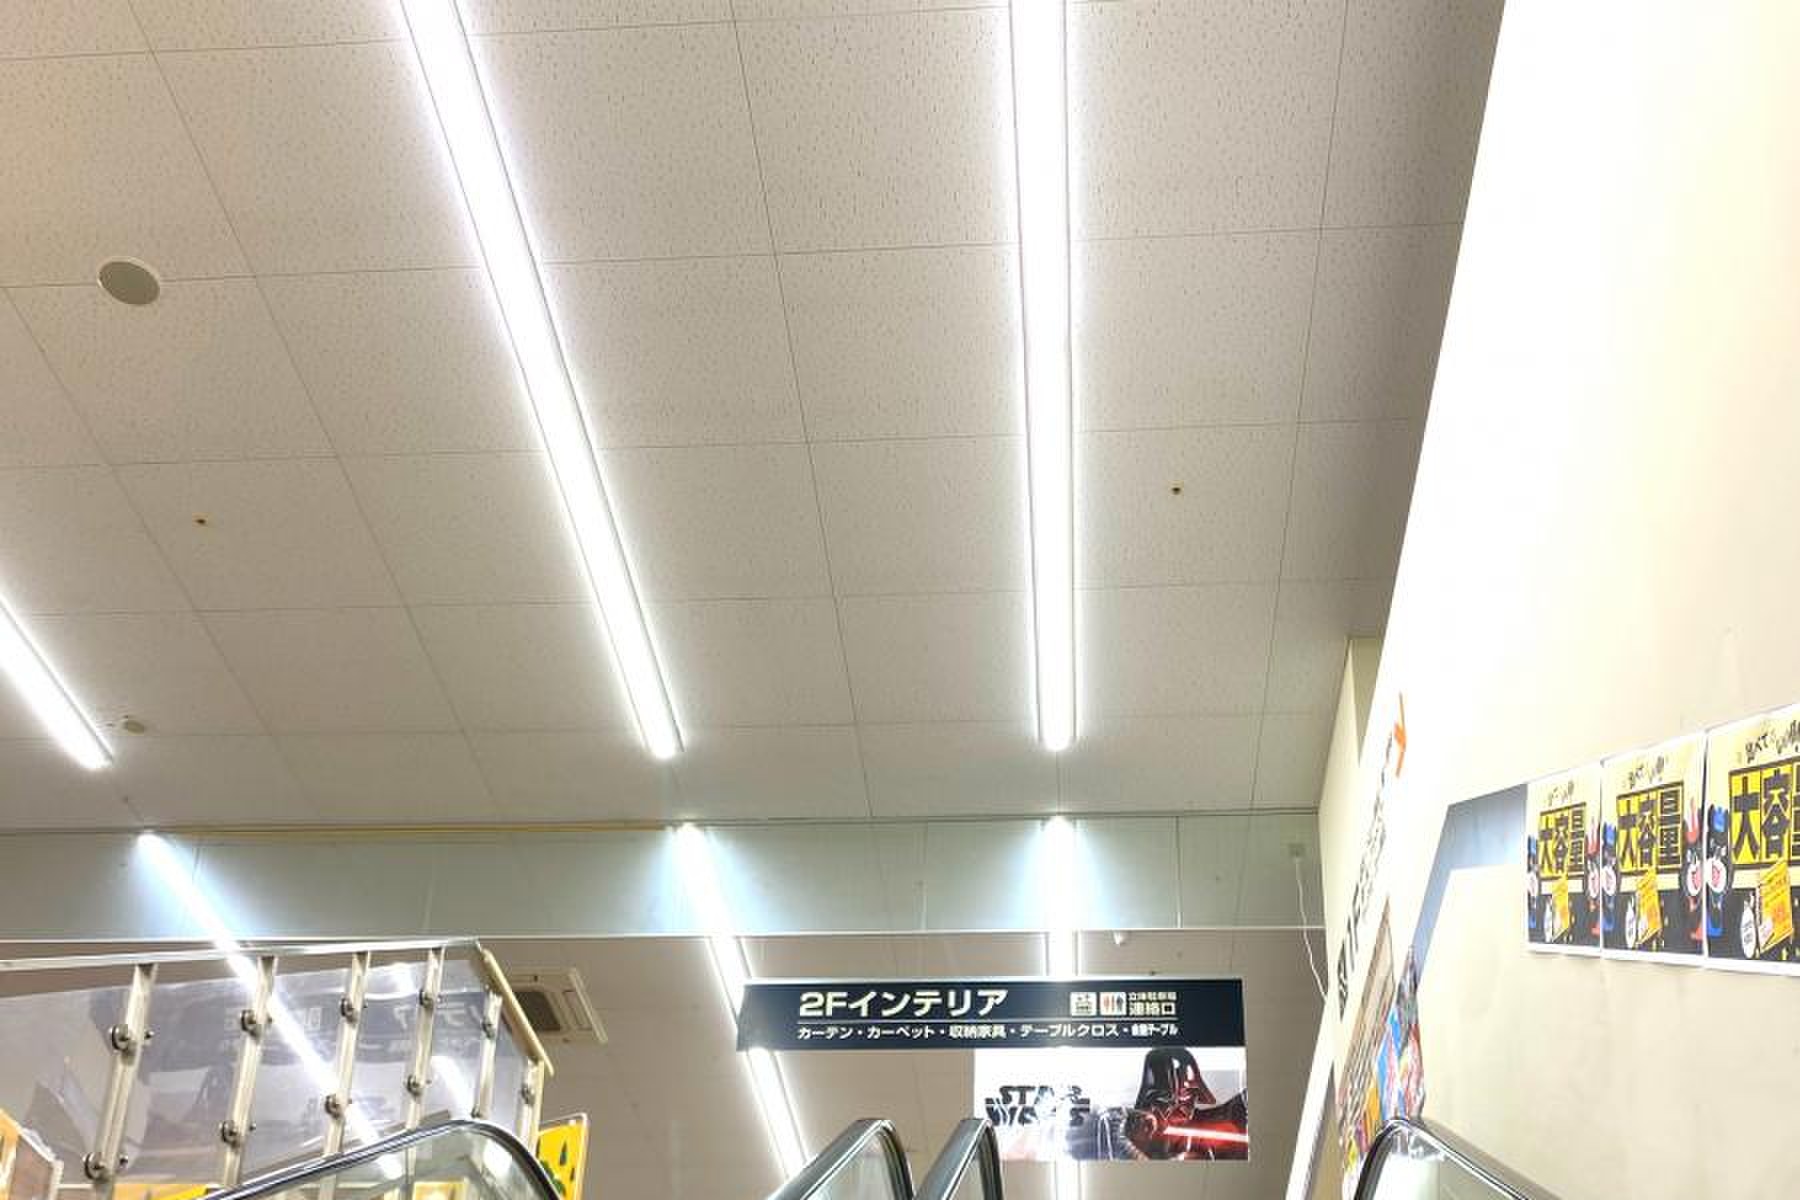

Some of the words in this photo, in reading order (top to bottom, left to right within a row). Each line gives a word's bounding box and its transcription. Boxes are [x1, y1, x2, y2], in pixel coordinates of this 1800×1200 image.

[1539, 807, 1584, 877] 大容量
[1618, 789, 1682, 868] 大容量
[799, 989, 1008, 1017] 2Fインテリア
[985, 1097, 1090, 1127] WAS
